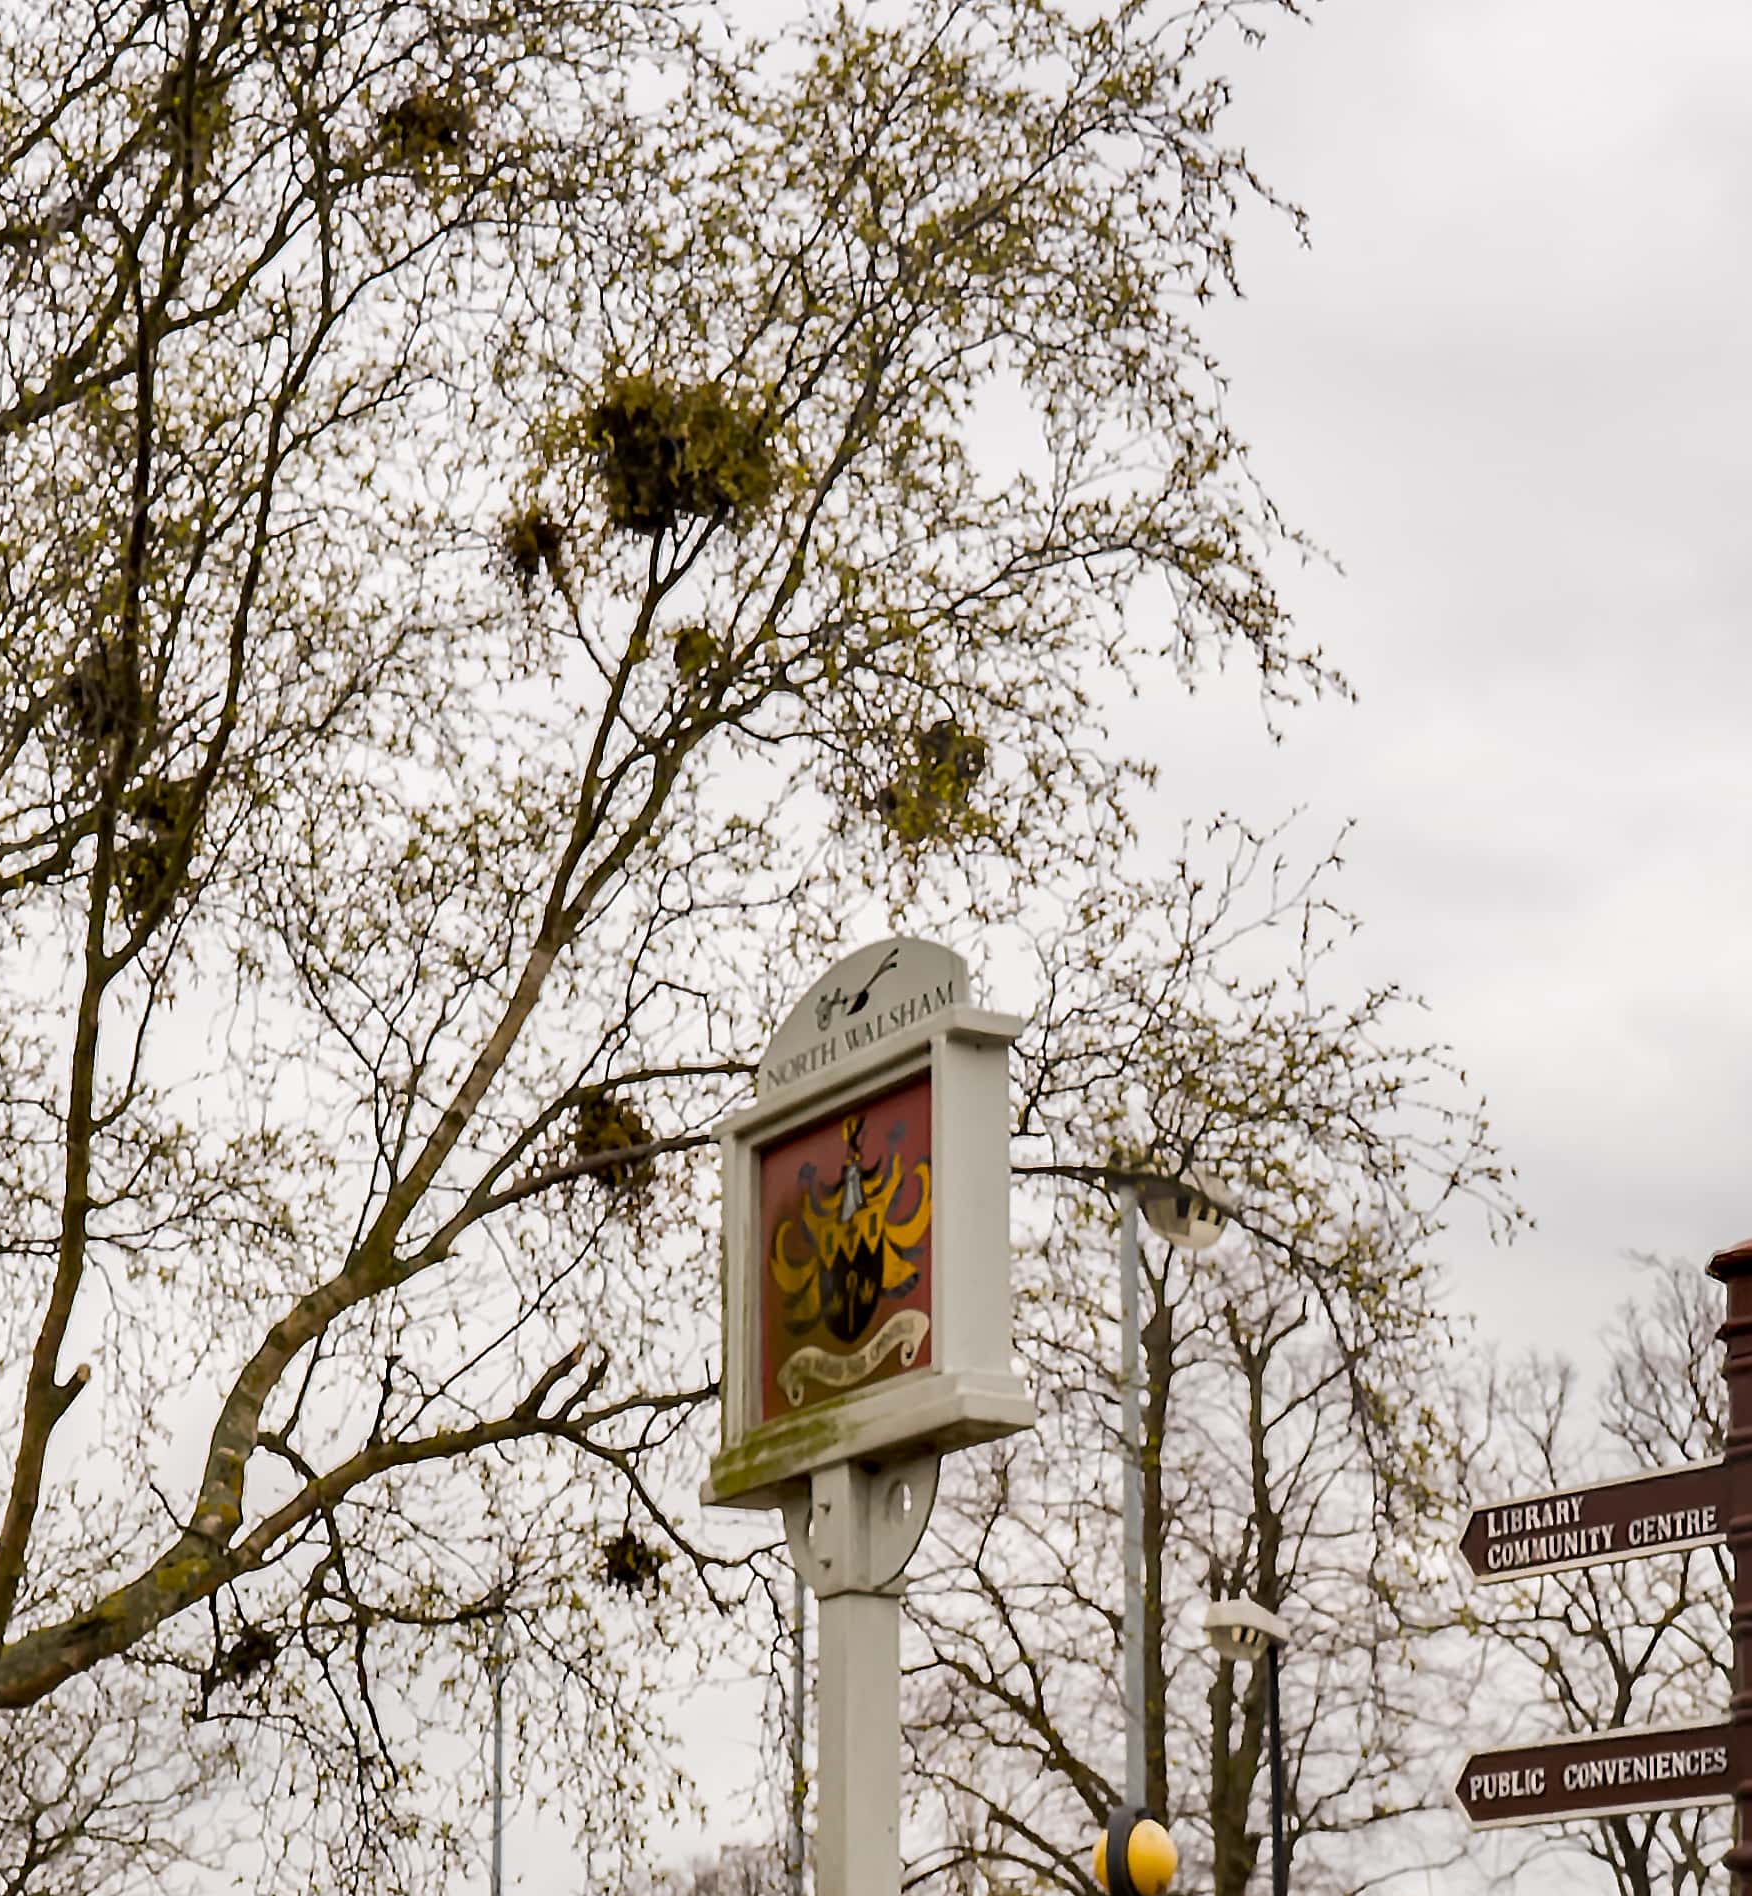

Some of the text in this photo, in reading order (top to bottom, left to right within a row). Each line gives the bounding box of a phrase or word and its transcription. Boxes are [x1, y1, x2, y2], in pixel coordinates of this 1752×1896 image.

[766, 981, 955, 1091] NORTH WALSHAM
[1486, 1496, 1584, 1539] LIBRARY
[1486, 1505, 1718, 1571] COMMUNITY CENTRE
[1468, 1746, 1728, 1801] PUBLIC CONVENIENCES
